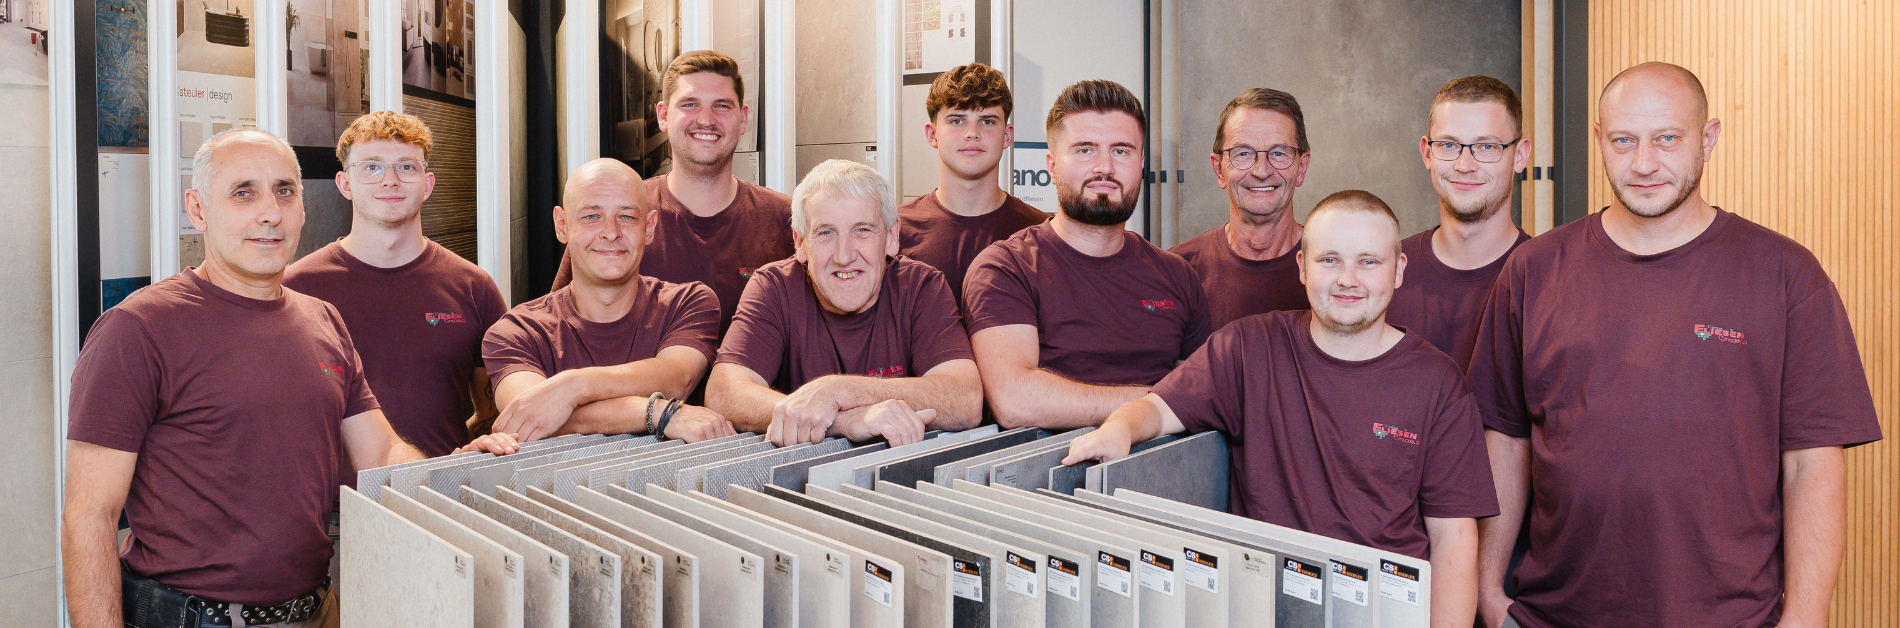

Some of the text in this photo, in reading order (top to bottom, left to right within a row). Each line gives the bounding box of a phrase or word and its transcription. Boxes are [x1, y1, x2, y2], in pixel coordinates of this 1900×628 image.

[179, 87, 233, 103] steuler design
[1694, 323, 1745, 339] FLIESEN
[1373, 422, 1418, 440] FLIESEN
